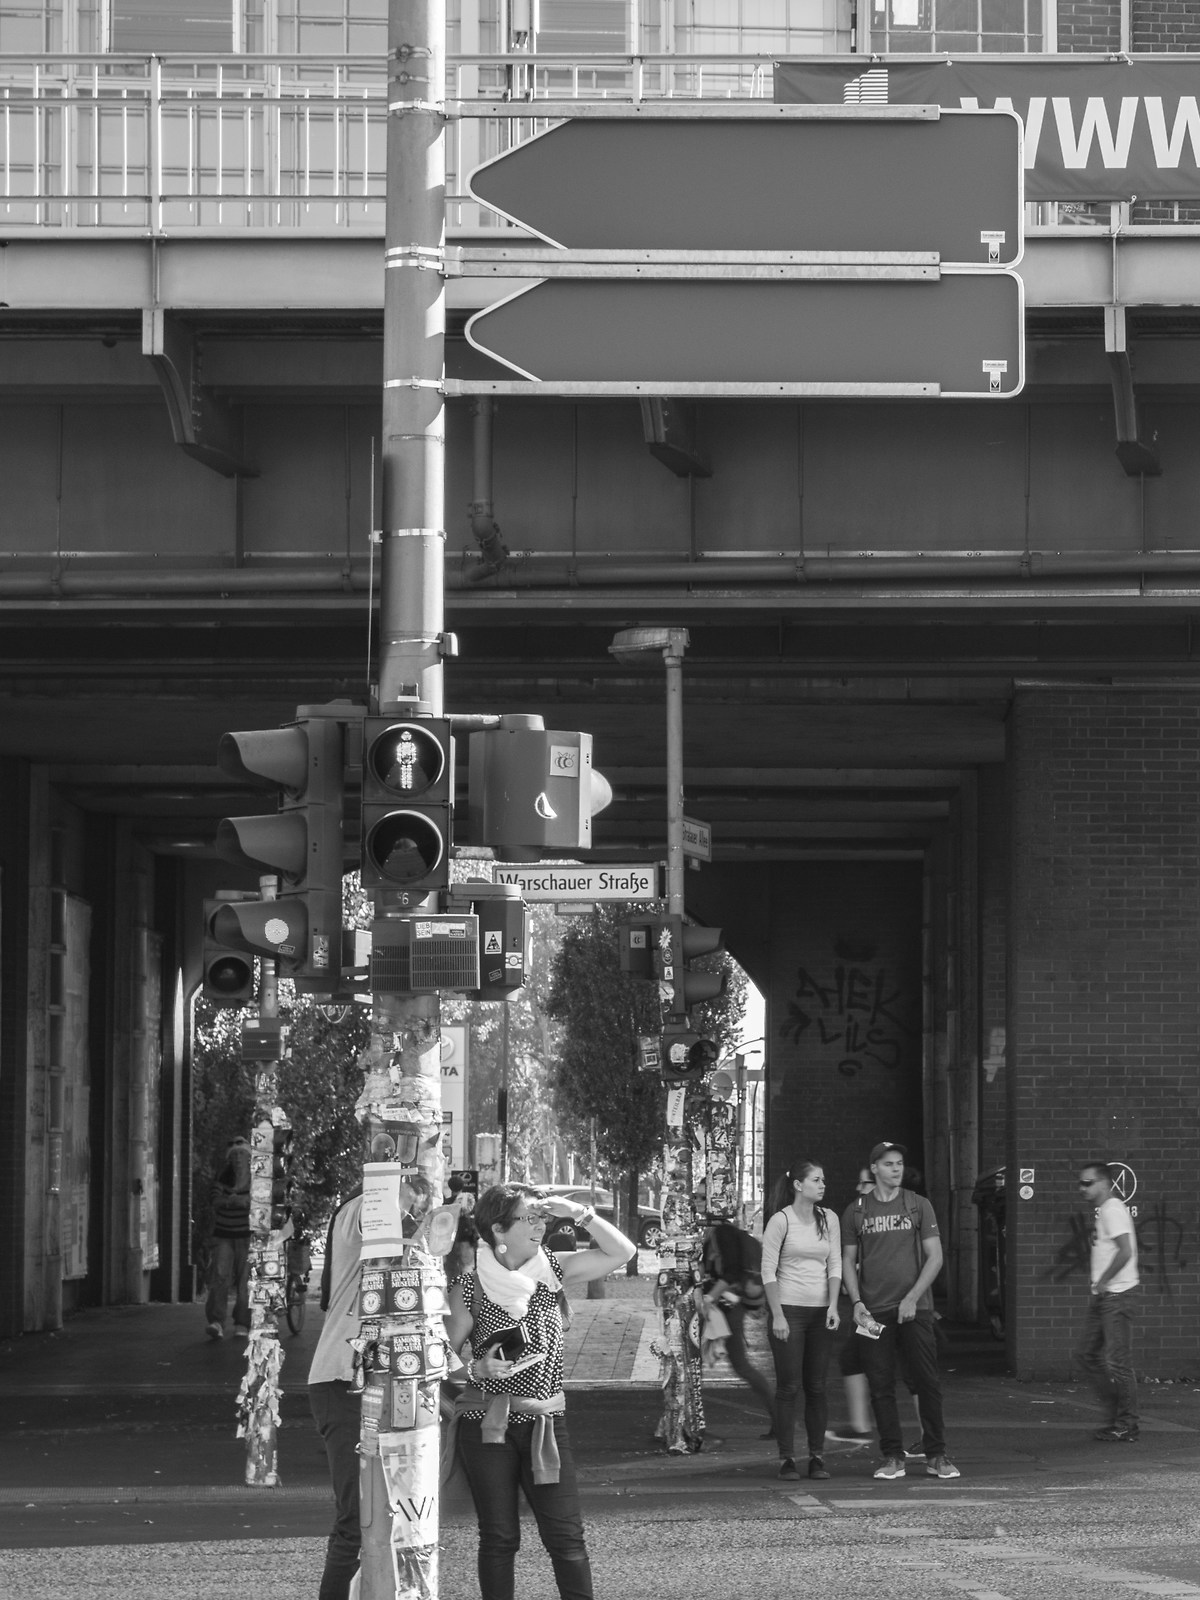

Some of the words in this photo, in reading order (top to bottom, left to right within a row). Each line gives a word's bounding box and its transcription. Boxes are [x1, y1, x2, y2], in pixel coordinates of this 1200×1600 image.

[499, 872, 593, 891] Warschauer
[598, 872, 649, 894] Straße
[440, 1066, 459, 1077] TA
